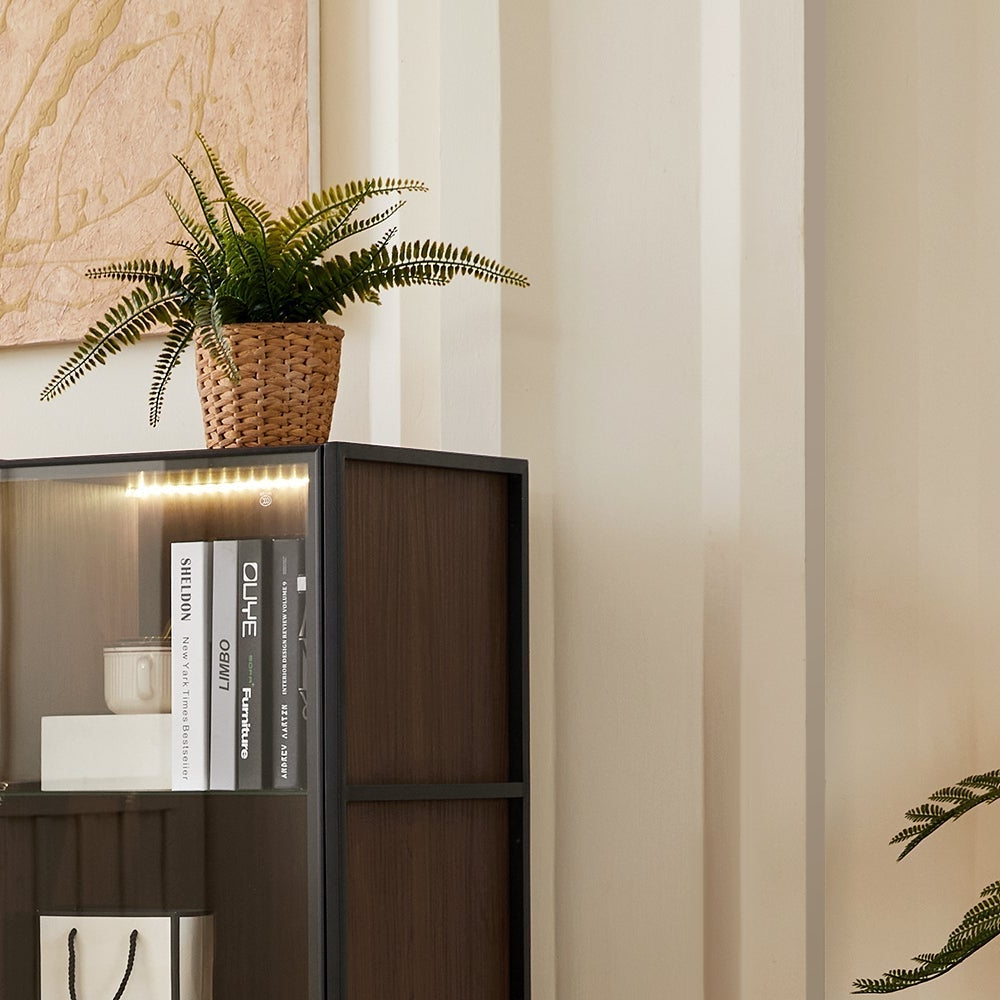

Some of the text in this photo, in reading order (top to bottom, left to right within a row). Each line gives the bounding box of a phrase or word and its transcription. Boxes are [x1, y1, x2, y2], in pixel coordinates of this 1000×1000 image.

[180, 557, 192, 621] SHELDON
[182, 636, 190, 660] New
[218, 638, 230, 691] LIMBO
[182, 689, 190, 722] Times
[241, 687, 252, 760] Furniture
